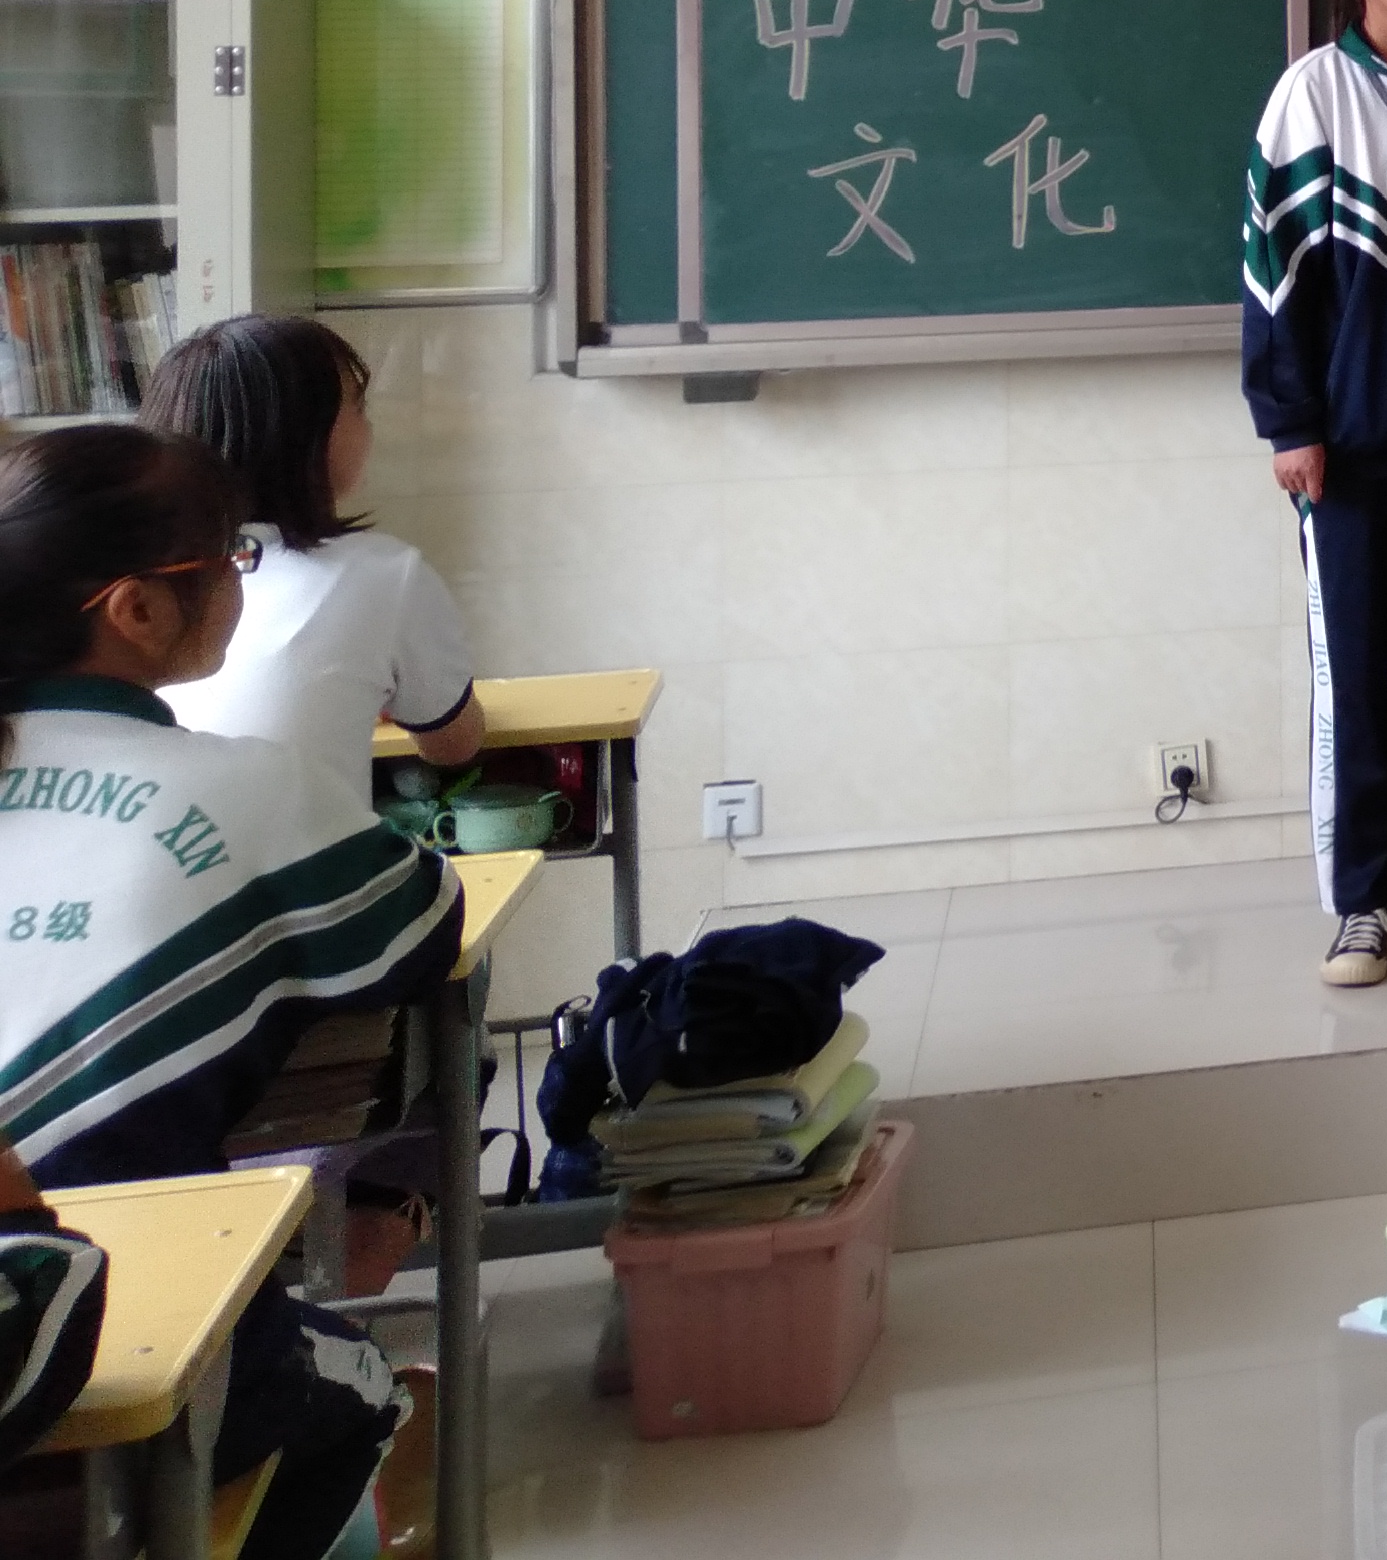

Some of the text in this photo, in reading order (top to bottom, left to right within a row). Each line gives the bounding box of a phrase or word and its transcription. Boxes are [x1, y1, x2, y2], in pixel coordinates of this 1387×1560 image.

[1313, 640, 1331, 688] JIAO
[1317, 712, 1335, 791] ZHONG
[153, 804, 232, 879] XIN
[1317, 815, 1336, 855] XIN
